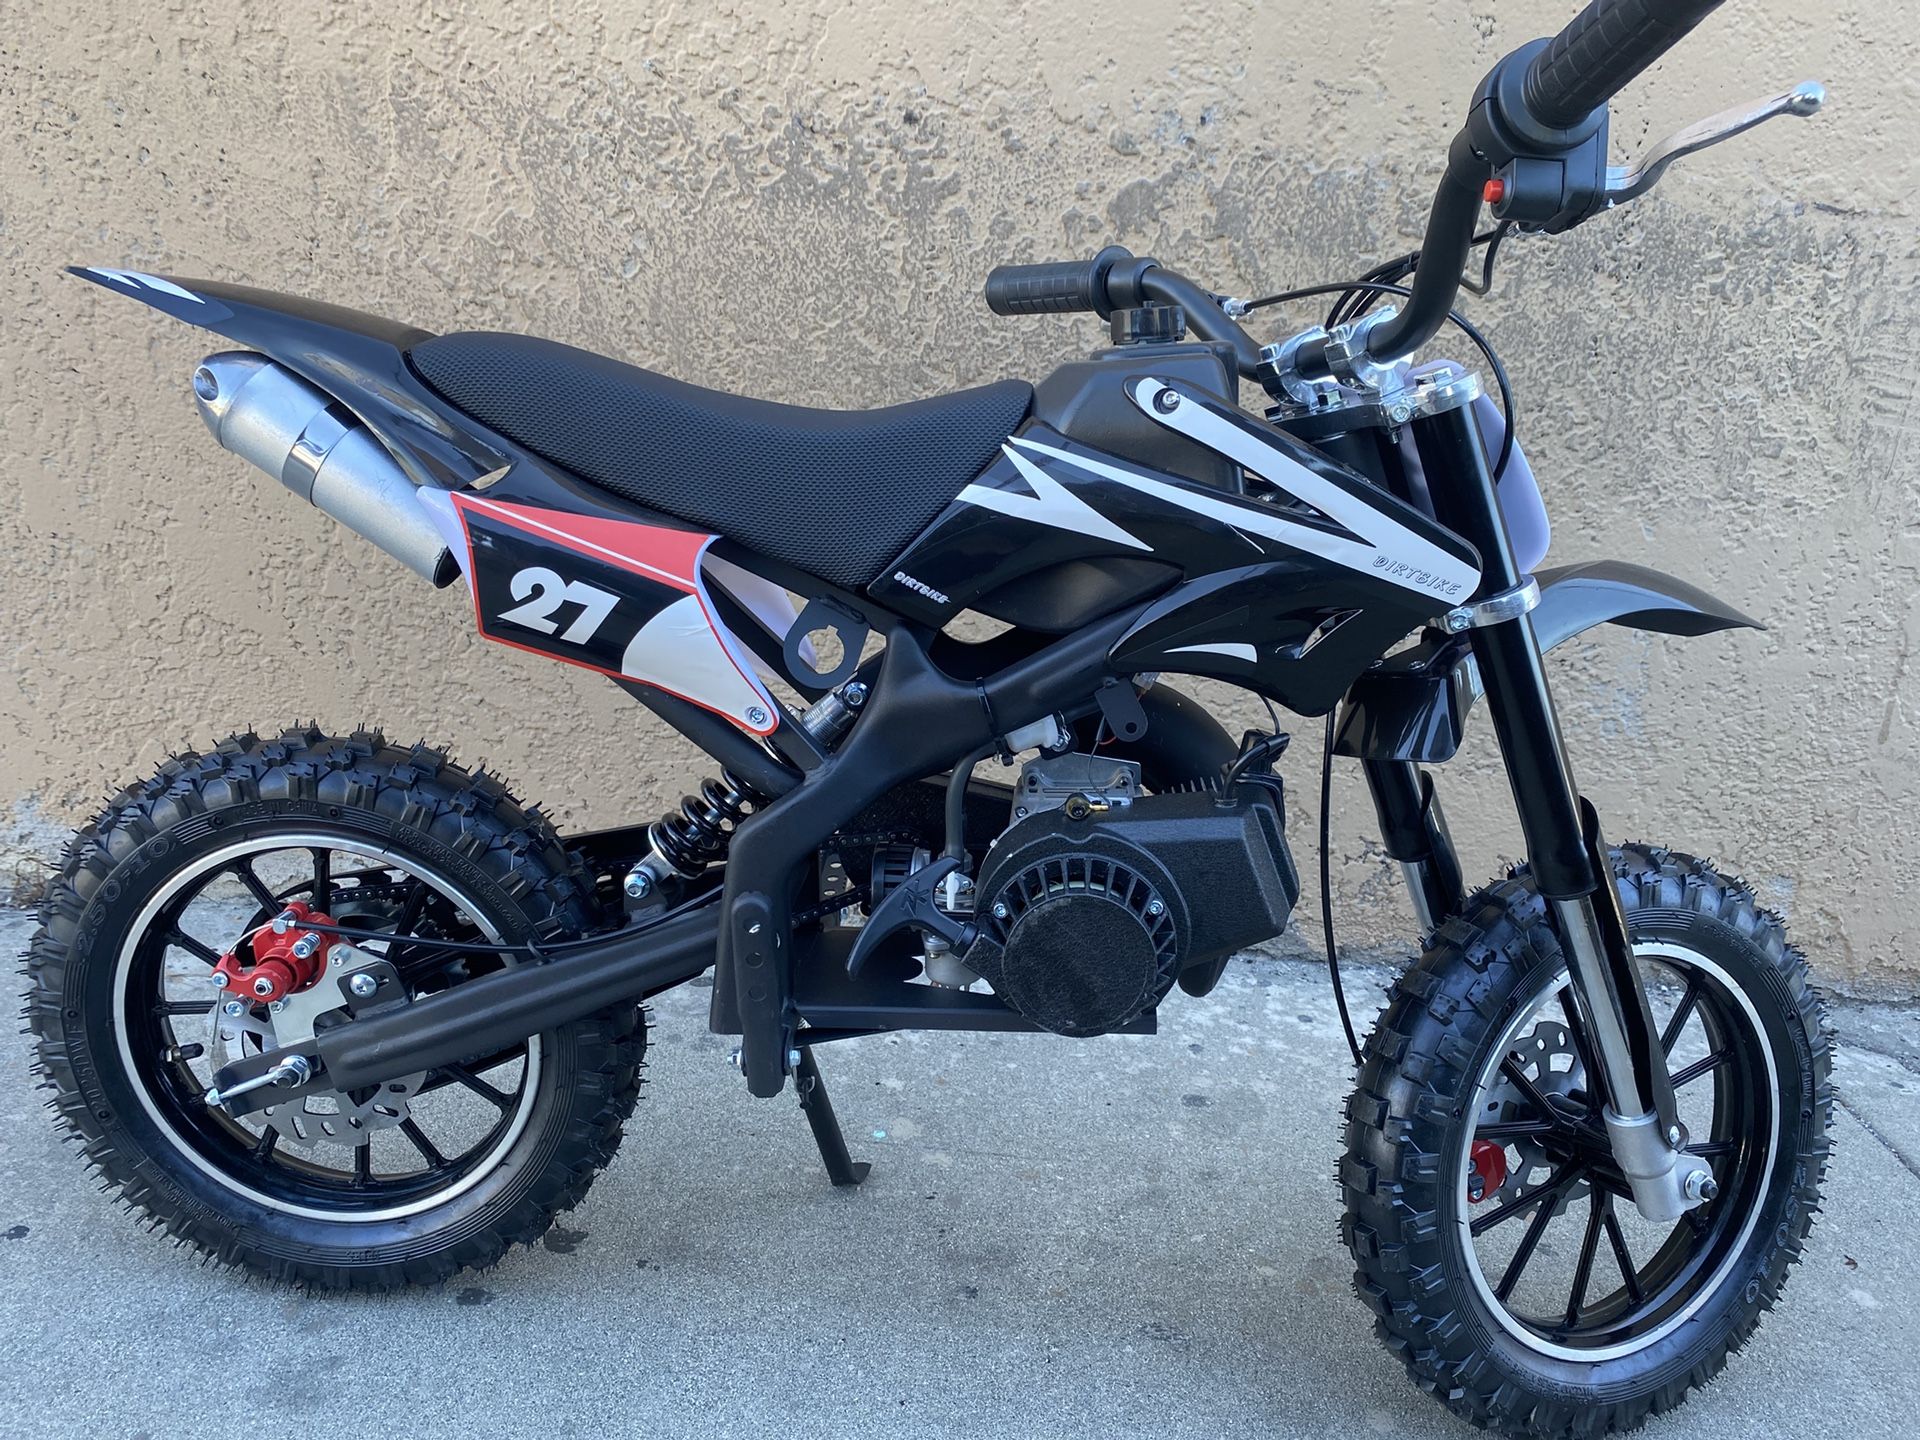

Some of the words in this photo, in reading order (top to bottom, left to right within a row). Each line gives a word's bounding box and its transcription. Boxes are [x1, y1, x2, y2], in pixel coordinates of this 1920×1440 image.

[893, 571, 951, 604] DIRTBIKE
[1372, 555, 1462, 595] DIRTBIKE
[497, 566, 621, 645] 27
[76, 837, 170, 955] 2.50-10
